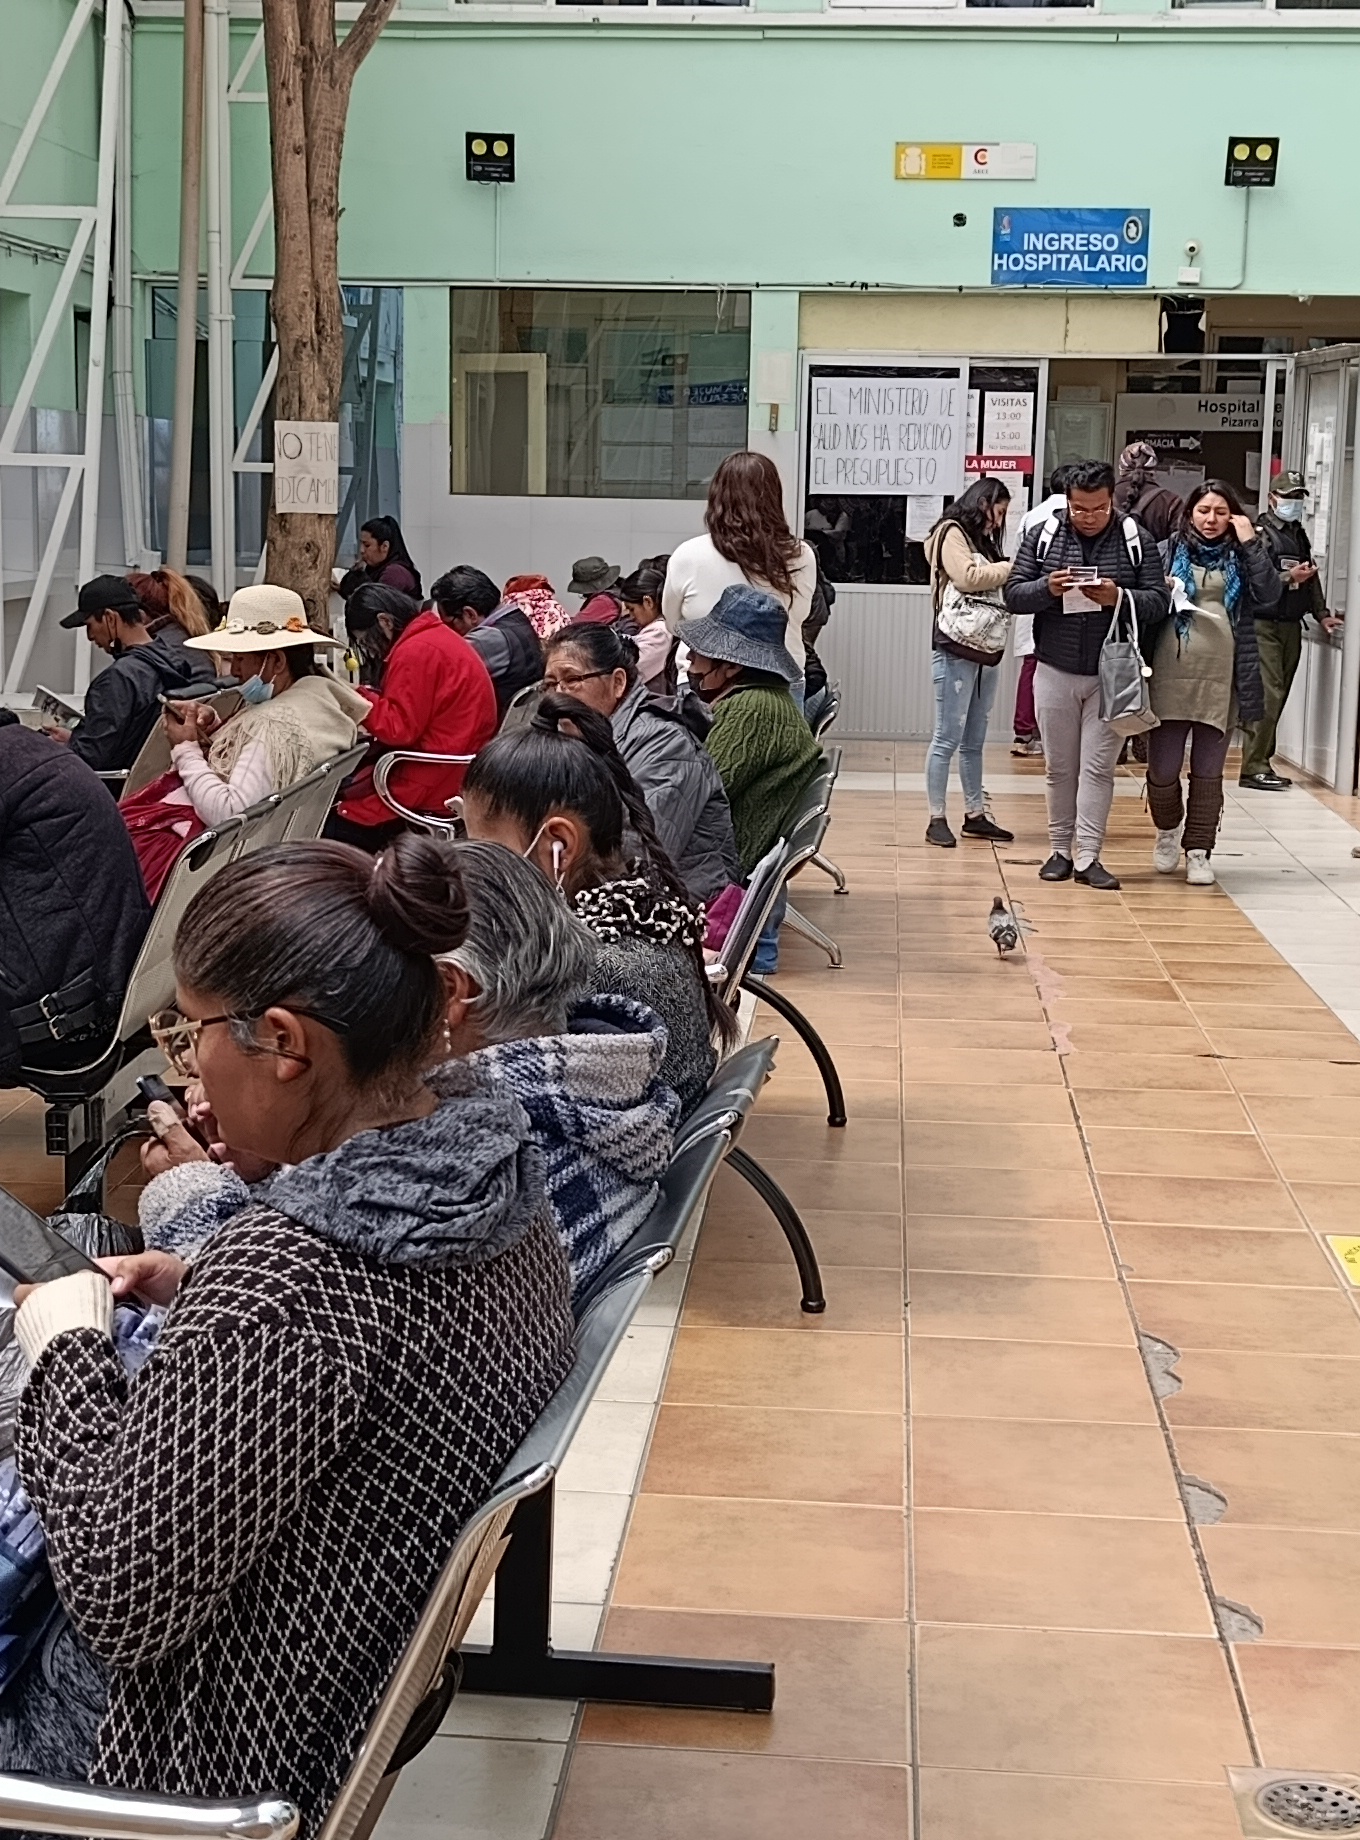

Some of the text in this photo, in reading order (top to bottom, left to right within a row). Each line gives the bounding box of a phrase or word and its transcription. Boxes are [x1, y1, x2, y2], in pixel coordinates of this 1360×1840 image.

[1023, 233, 1119, 251] INGRESO
[993, 253, 1147, 272] HOSPITALARIO
[816, 387, 837, 415] EL
[940, 387, 957, 417] DE
[991, 397, 1028, 407] VISITAS
[1198, 400, 1260, 417] Hospital
[996, 412, 1022, 421] 13:00
[1221, 417, 1259, 428] Pizarra
[813, 422, 952, 451] SALUD NOS HA REDUCIDO
[995, 431, 1021, 440] 15:00
[814, 457, 937, 486] EL PRESUPUESTO
[966, 459, 1017, 470] LA MUJER
